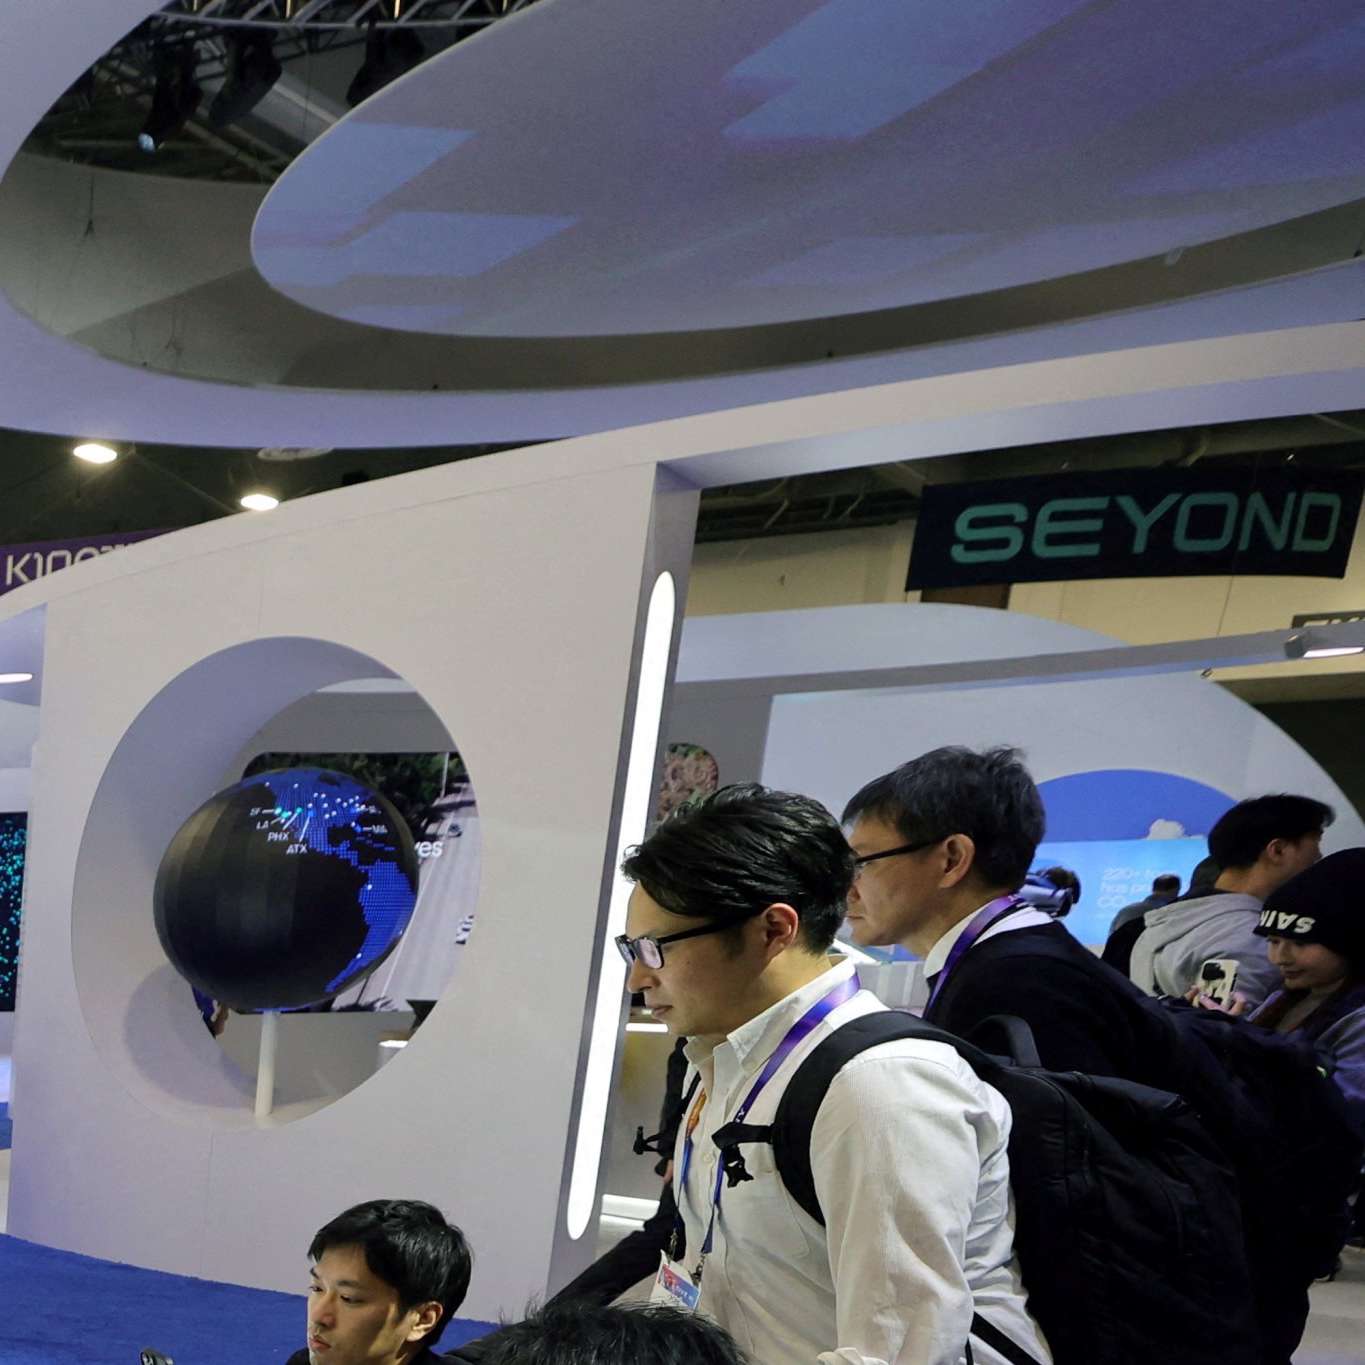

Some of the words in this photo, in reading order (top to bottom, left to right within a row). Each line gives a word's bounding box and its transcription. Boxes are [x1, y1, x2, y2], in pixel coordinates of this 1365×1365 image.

[950, 491, 1342, 564] SEYOND
[267, 831, 290, 842] PHX
[286, 843, 308, 855] ATX
